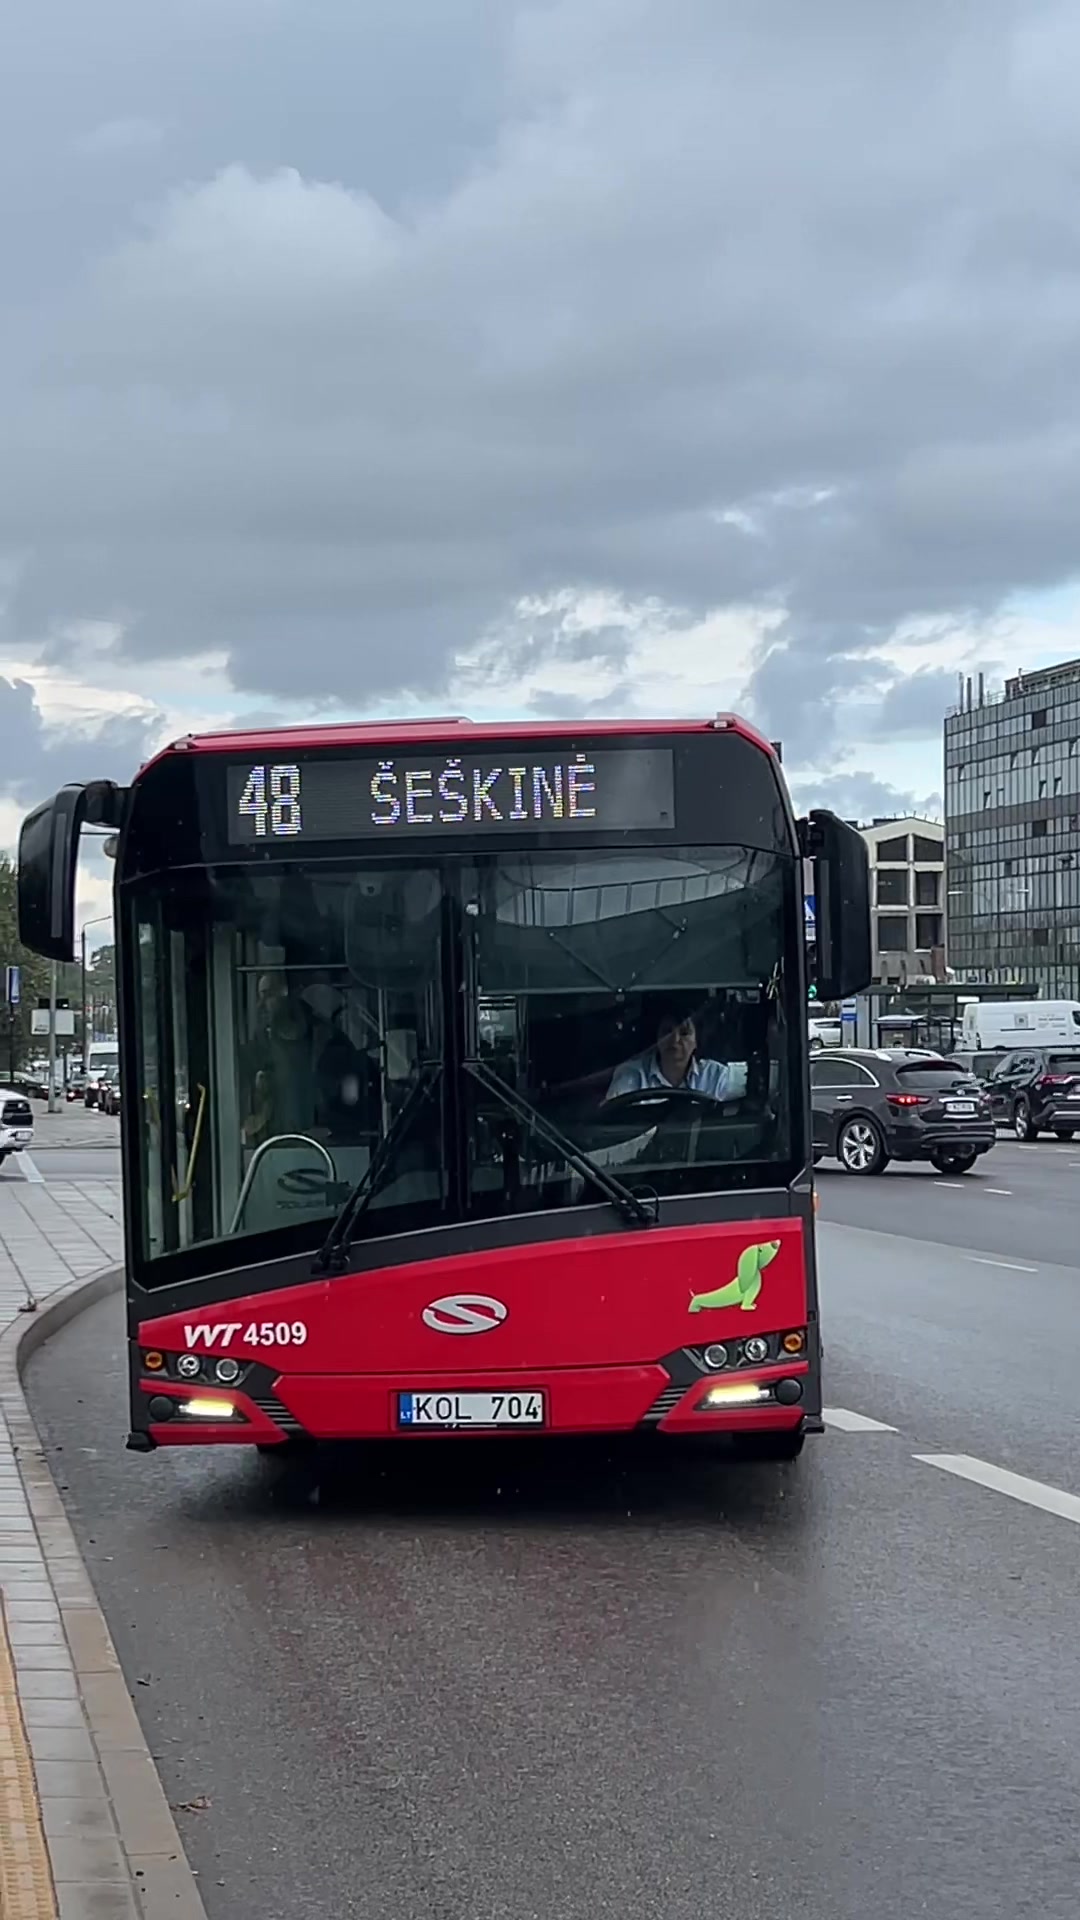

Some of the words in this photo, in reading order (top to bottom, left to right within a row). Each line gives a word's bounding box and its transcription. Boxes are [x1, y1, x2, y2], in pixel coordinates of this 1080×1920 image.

[238, 765, 301, 835] 48
[371, 754, 596, 824] ŠEŠKINĖ
[243, 1321, 307, 1346] 4509
[400, 1411, 411, 1419] LT
[416, 1397, 472, 1420] KOL
[491, 1396, 538, 1419] 704
